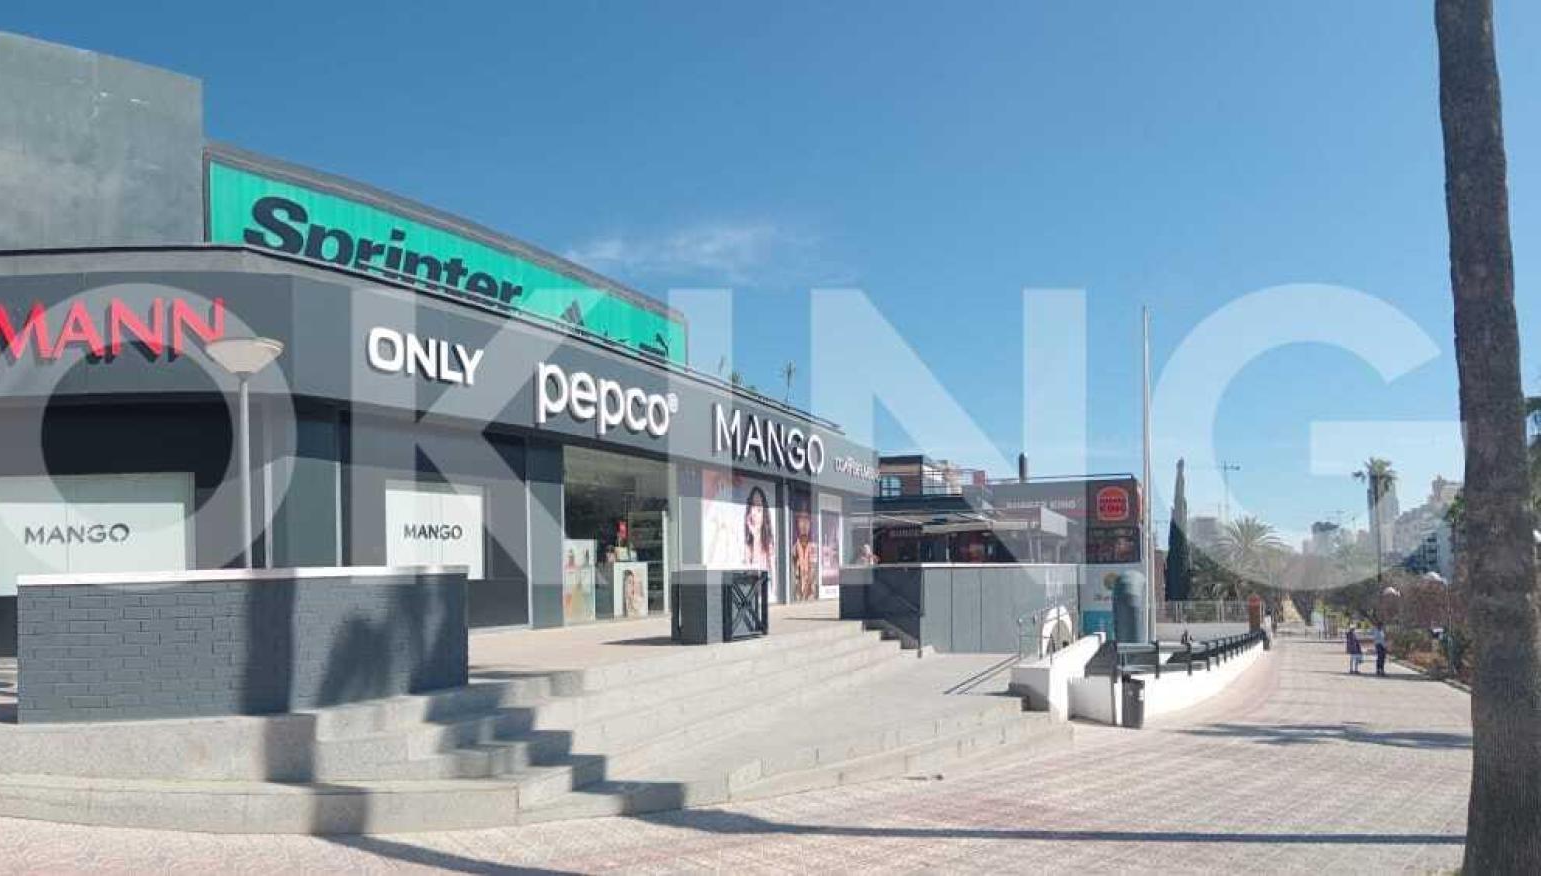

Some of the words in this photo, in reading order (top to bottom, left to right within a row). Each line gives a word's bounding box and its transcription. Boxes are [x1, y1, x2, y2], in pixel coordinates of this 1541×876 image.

[243, 196, 523, 312] Sprinter
[368, 327, 484, 385] ONLY
[714, 403, 824, 474] MANGO
[24, 523, 130, 545] MANGO
[404, 524, 462, 540] MANGO
